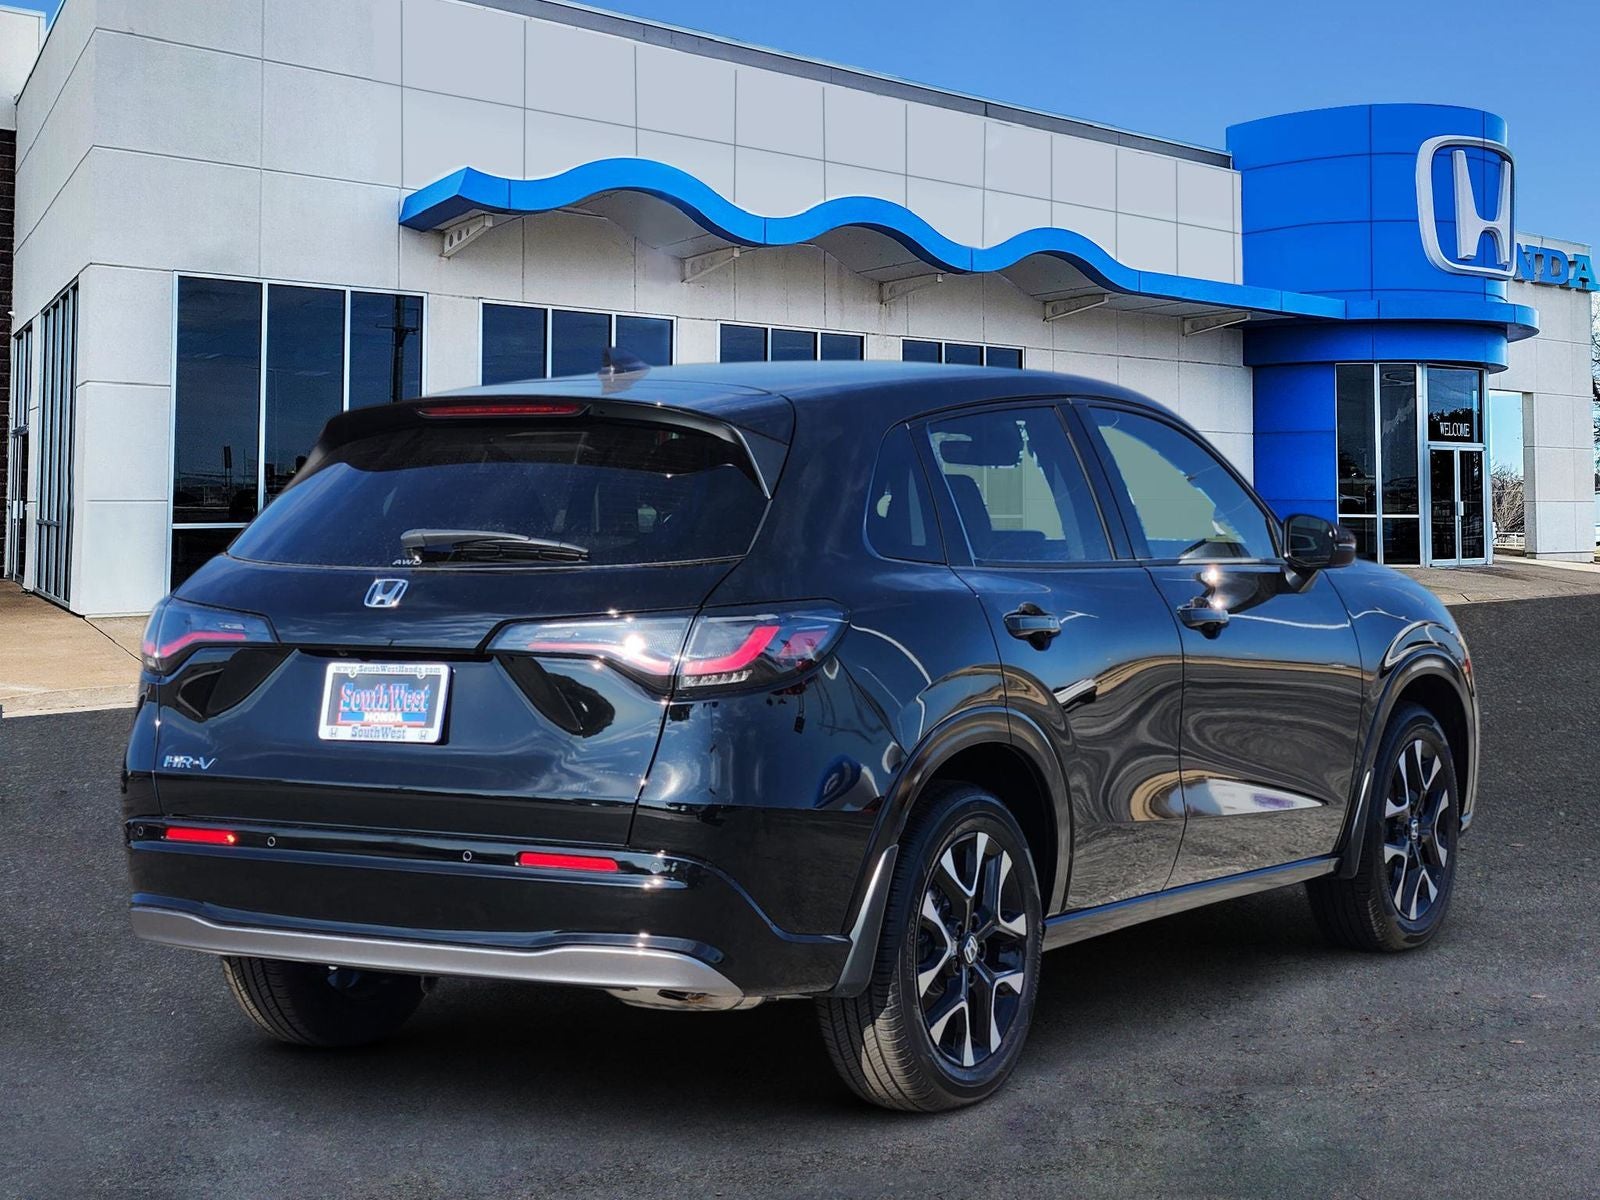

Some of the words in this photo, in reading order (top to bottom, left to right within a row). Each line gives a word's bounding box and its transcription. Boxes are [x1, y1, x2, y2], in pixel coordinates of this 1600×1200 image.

[1514, 243, 1600, 291] NDA
[1440, 422, 1470, 437] WELCOME
[163, 755, 216, 770] HR-V
